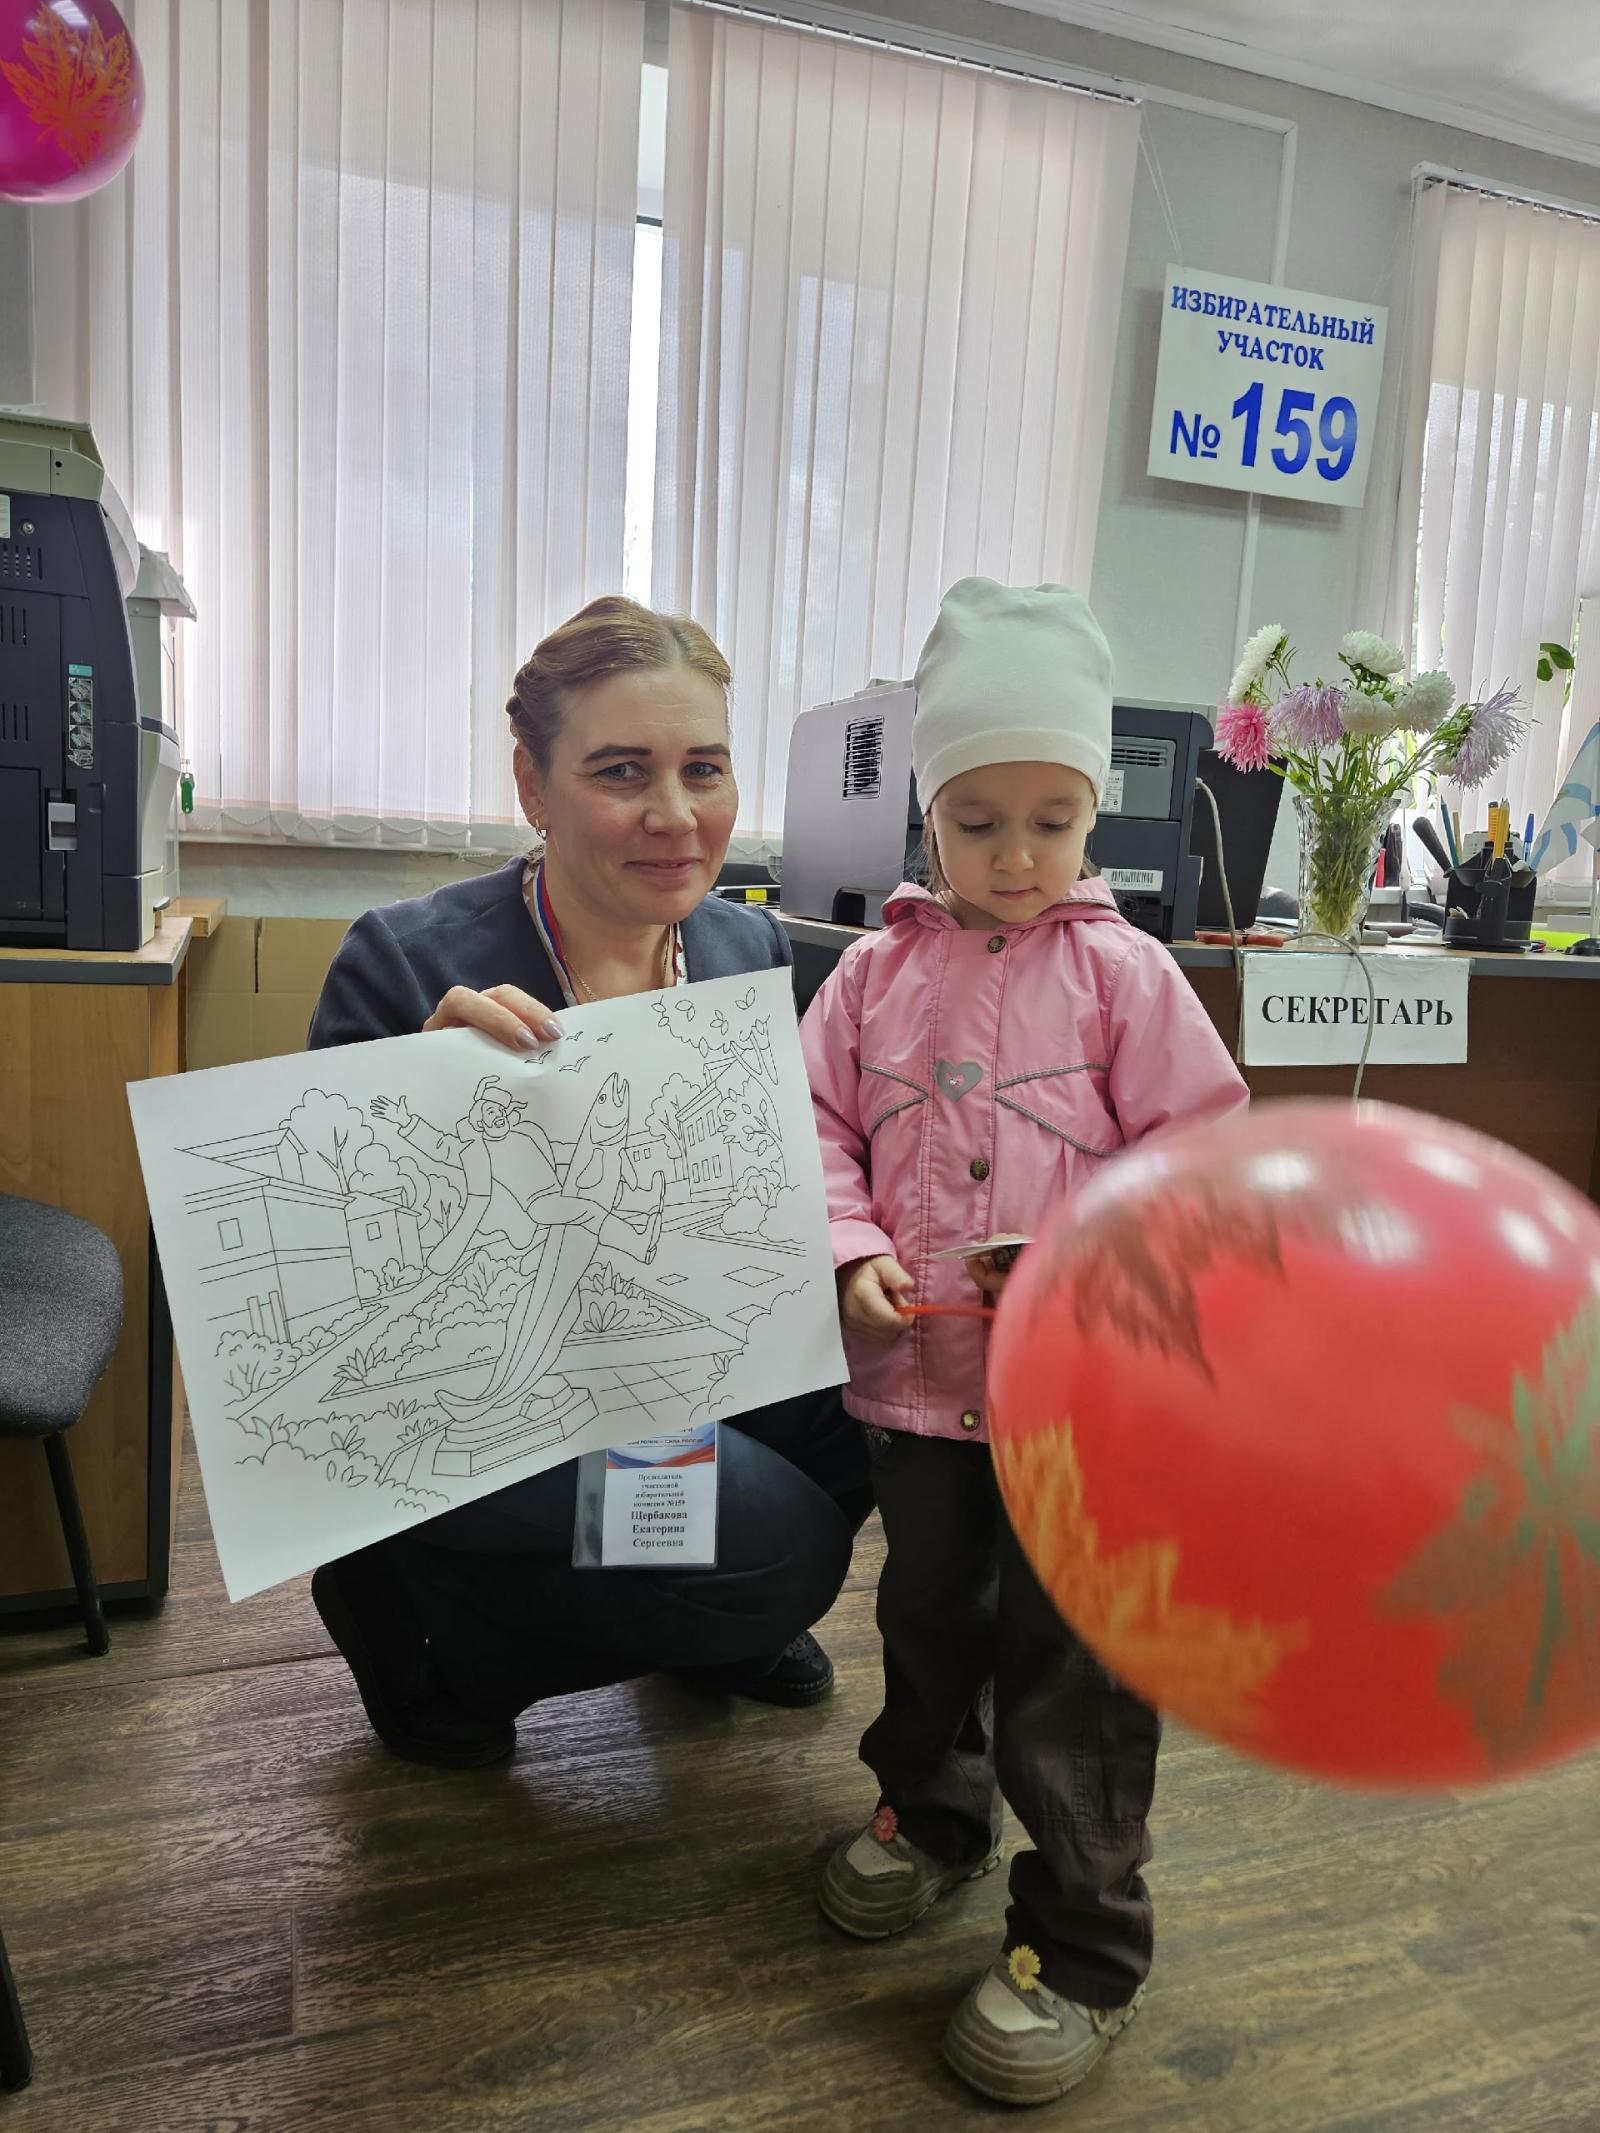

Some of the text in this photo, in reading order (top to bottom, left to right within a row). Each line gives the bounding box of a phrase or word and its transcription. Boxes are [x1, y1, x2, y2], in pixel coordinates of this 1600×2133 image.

[1171, 286, 1375, 345] ИЗБИРАТЕЛЬНЫЙ
[1217, 330, 1325, 370] УЧАСТОК
[1170, 381, 1358, 481] № 159
[1261, 995, 1453, 1026] СЕКРЕТАРЬ
[631, 1511, 688, 1522] Щербакова
[632, 1525, 685, 1535] Екатерина
[632, 1538, 684, 1549] Сергеевна
